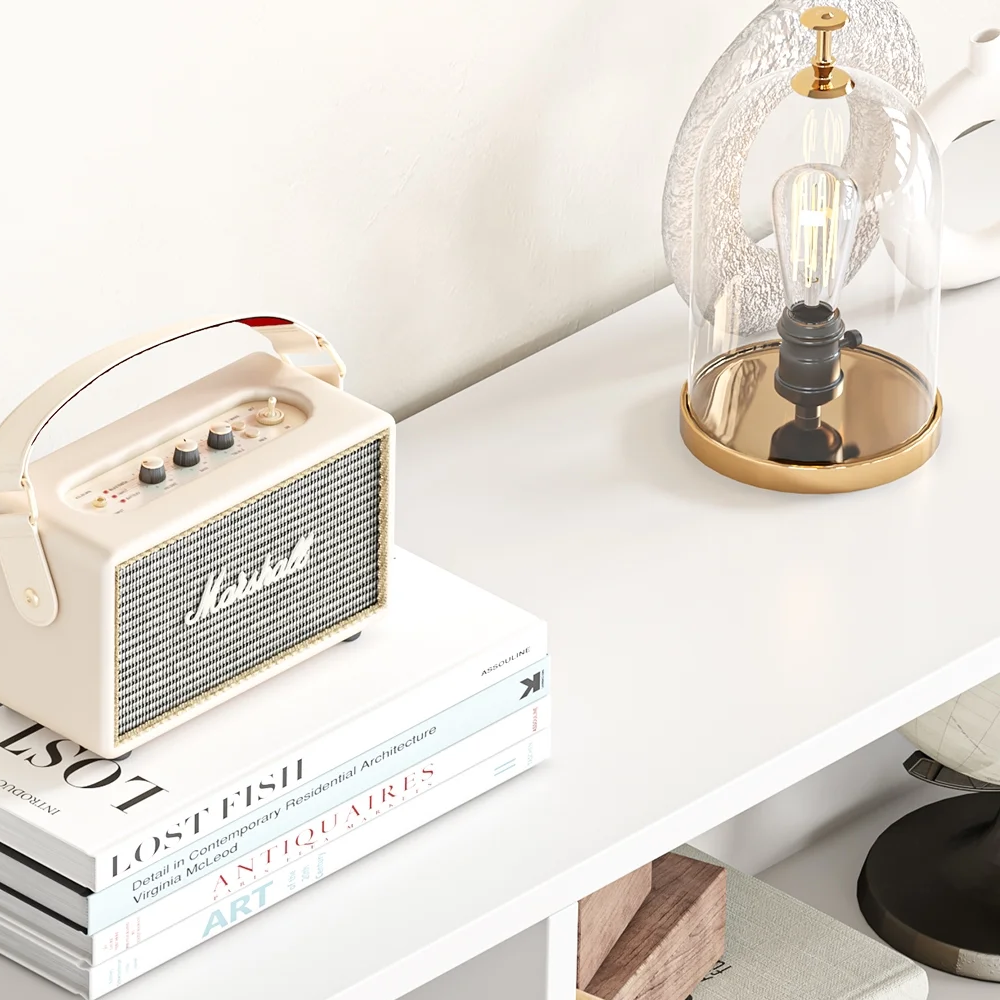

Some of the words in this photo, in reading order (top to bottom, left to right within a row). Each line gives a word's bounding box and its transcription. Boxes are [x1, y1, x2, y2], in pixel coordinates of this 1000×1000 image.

[481, 646, 531, 677] ASSOULINE
[112, 807, 211, 878] LOST
[221, 757, 305, 821] FISH
[131, 865, 170, 892] Detail
[172, 858, 185, 873] in
[188, 808, 282, 864] Contemporary
[285, 767, 357, 810] Residential
[360, 724, 438, 772] Architecture
[213, 762, 435, 893] ANTIQUAIRES
[133, 874, 182, 904] Virginia
[184, 842, 239, 881] McLeod
[202, 880, 274, 938] ART
